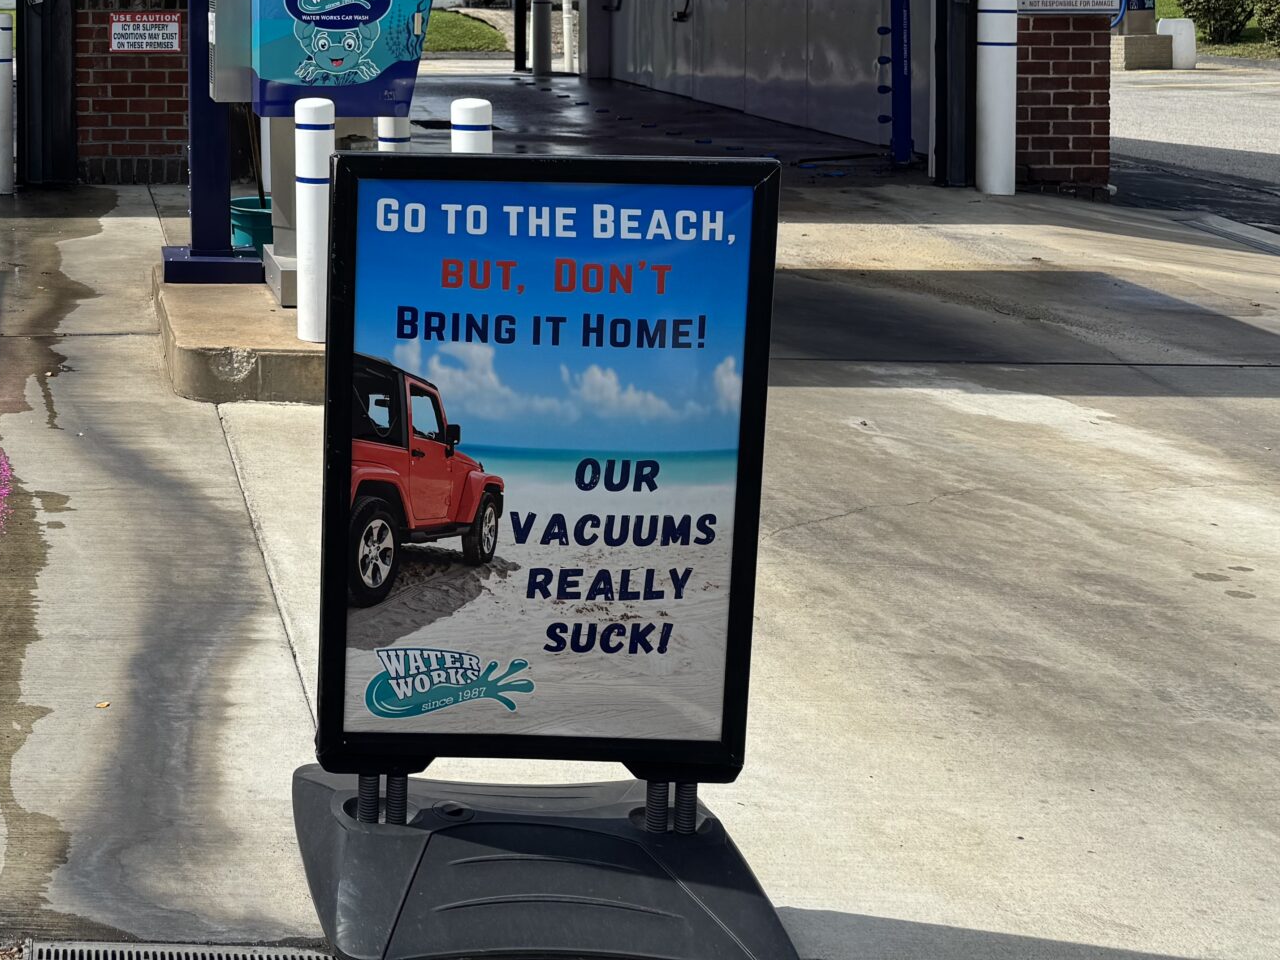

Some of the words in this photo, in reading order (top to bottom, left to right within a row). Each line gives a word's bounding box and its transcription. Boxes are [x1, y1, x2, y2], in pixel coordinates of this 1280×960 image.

[375, 197, 426, 234] GO
[441, 203, 488, 236] TO
[502, 205, 577, 239] THE
[593, 201, 736, 244] BEACH,
[440, 257, 525, 295] BUT,
[395, 306, 517, 344] BRING
[532, 315, 566, 346] IT
[582, 313, 707, 349] HOME!
[574, 457, 661, 493] OUR
[509, 511, 717, 547] VACUUMS
[526, 567, 693, 600] REALLY
[543, 621, 673, 654] SUCK!
[378, 649, 480, 677] WATER
[388, 668, 478, 700] WORKS
[422, 696, 454, 711] since
[458, 687, 485, 701] 1987
